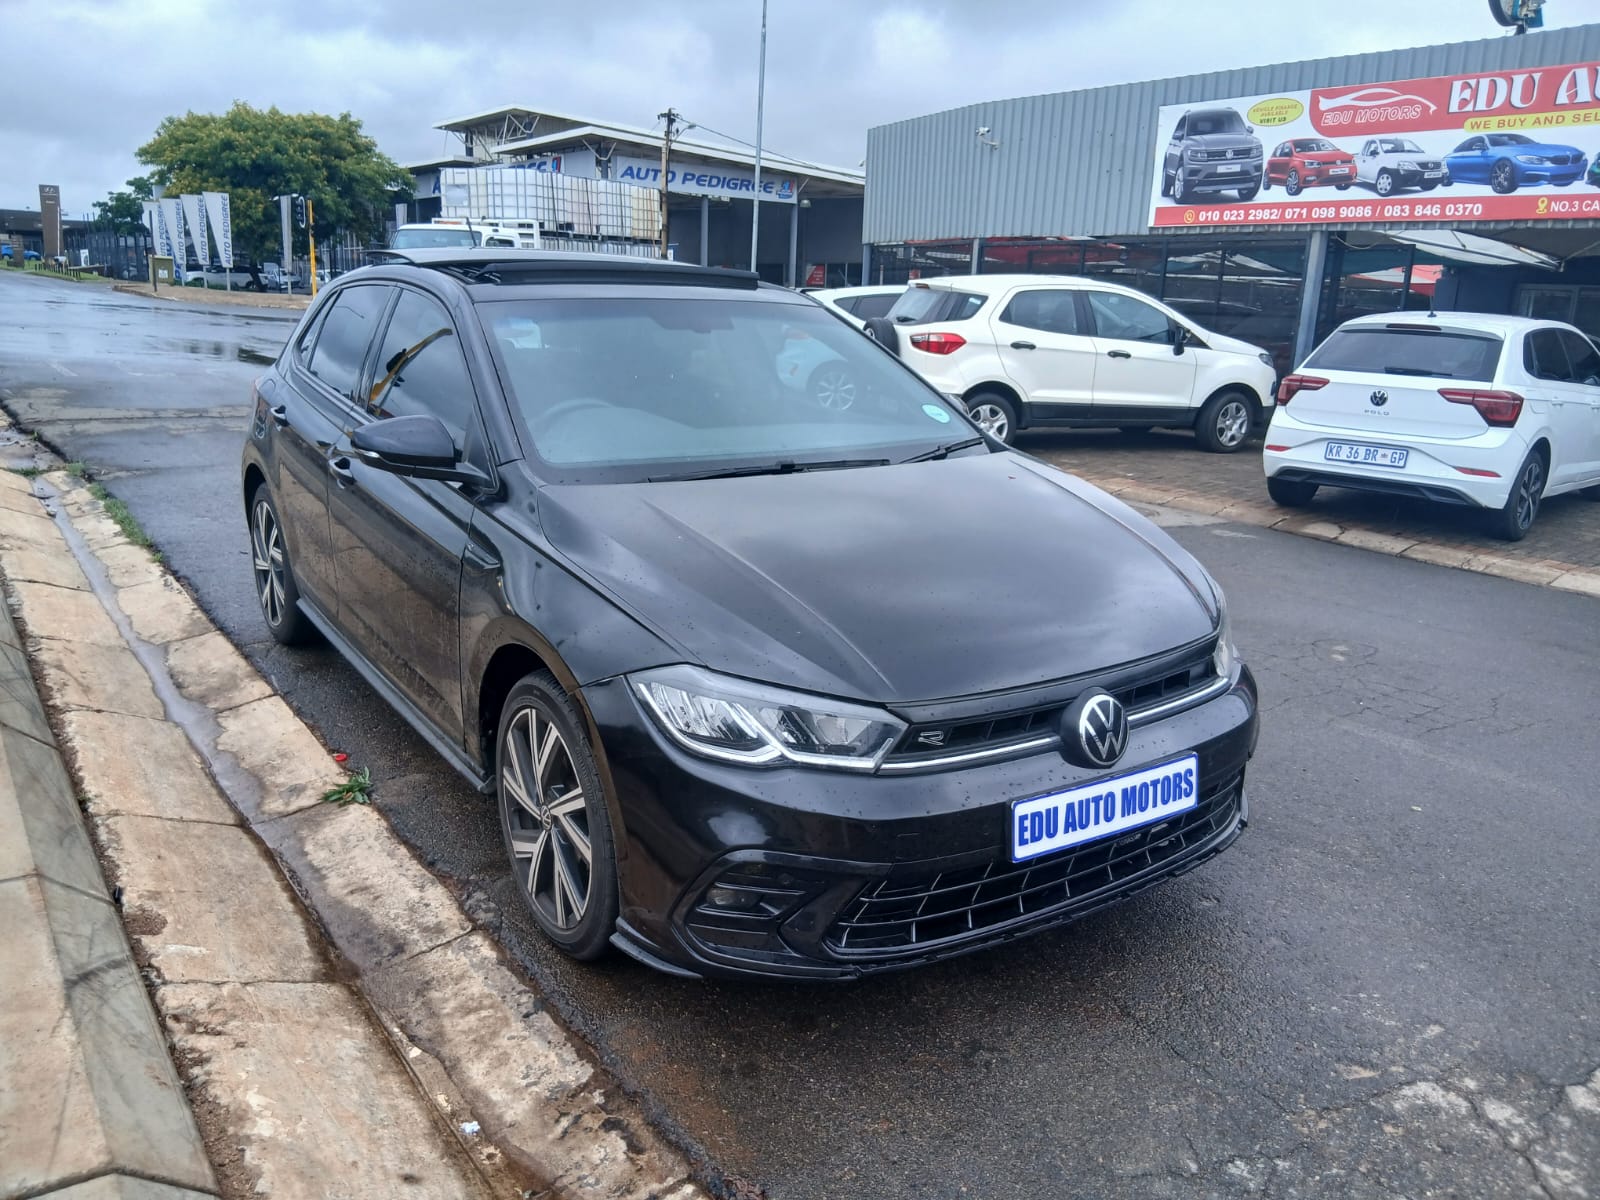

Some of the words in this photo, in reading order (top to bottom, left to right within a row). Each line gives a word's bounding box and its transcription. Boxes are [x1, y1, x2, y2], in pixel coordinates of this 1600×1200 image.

[1448, 72, 1543, 114] EDU
[1321, 111, 1353, 126] EDU
[1355, 105, 1422, 123] MOTORS
[1470, 120, 1491, 130] WE
[1497, 118, 1527, 129] BUY
[1532, 115, 1565, 126] AND
[620, 165, 676, 184] AUTO
[681, 172, 775, 194] PEDIGREE
[221, 195, 230, 240] PEDIGREE
[1198, 210, 1220, 222] 010
[1223, 210, 1245, 221] 023
[1284, 208, 1307, 219] 071
[1311, 207, 1336, 219] 098
[1339, 206, 1372, 218] 9086
[1384, 205, 1410, 217] 083
[1414, 204, 1441, 217] 846
[1445, 203, 1483, 216] 0370
[1550, 200, 1579, 213] NO.3
[197, 197, 206, 239] PEDIGREE
[200, 241, 208, 263] AUTO
[223, 242, 231, 265] AUTO
[1327, 445, 1343, 458] KR
[1346, 446, 1360, 460] 36
[1363, 448, 1379, 461] BR
[1390, 451, 1405, 465] GP
[1018, 805, 1059, 847] EDU
[1063, 791, 1116, 834] AUTO
[1120, 768, 1194, 819] MOTORS
